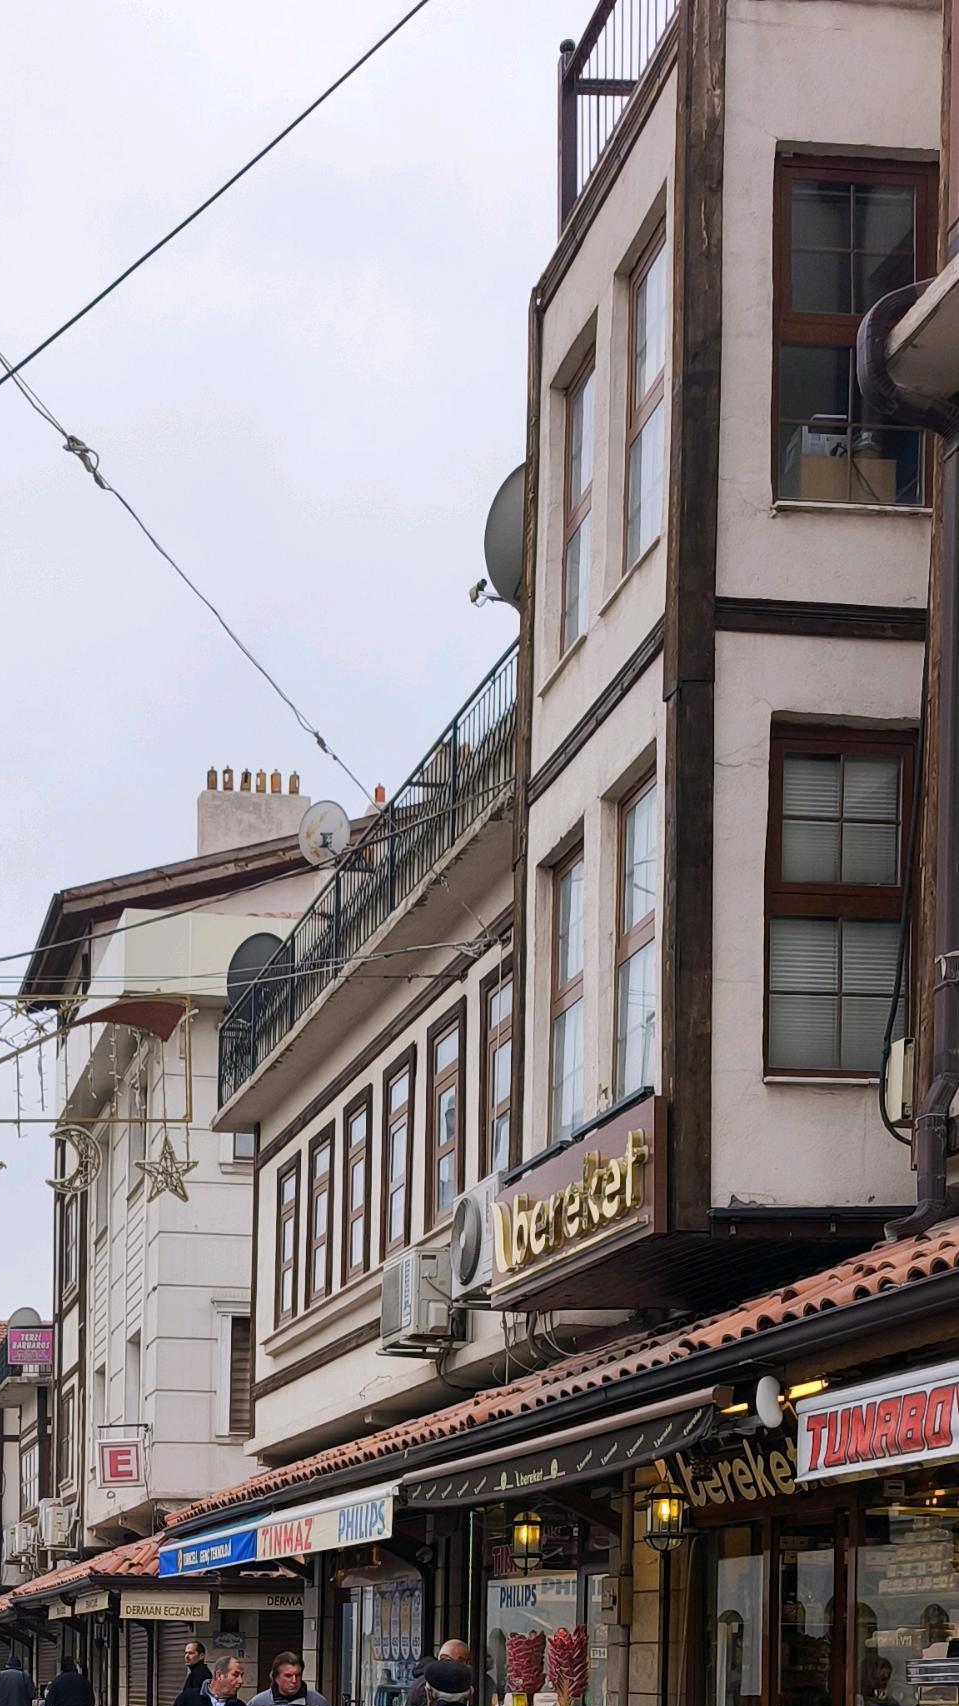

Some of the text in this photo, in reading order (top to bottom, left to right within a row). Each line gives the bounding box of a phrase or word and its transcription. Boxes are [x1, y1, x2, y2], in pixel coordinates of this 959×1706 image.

[807, 1383, 959, 1472] TUNABO
[109, 1450, 133, 1477] E
[336, 1500, 386, 1542] PHILIPS
[262, 1518, 313, 1557] TINMAZ
[267, 1596, 303, 1607] DERMA
[500, 1584, 536, 1608] PHILIPS
[126, 1605, 204, 1618] DERMAN ECZANESİ
